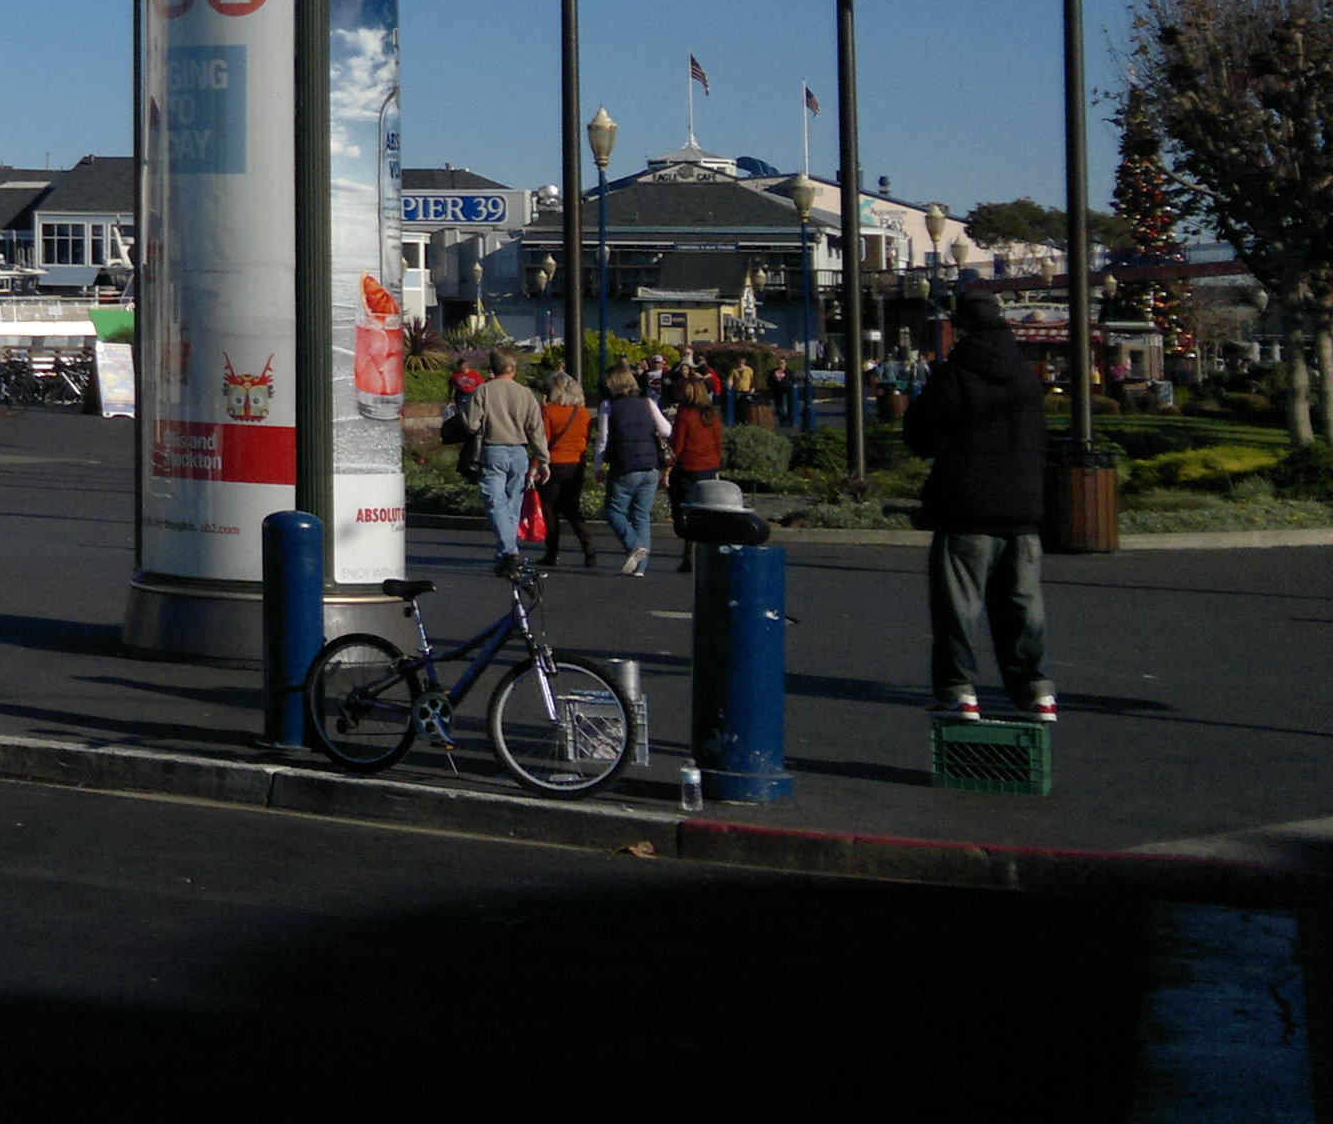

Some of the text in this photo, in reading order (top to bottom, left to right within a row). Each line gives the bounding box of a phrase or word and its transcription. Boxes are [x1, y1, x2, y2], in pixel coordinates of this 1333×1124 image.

[653, 173, 717, 182] EAGLE CAFE
[402, 197, 504, 221] PIER 39
[190, 433, 217, 450] and
[356, 508, 401, 523] ABSOLUT
